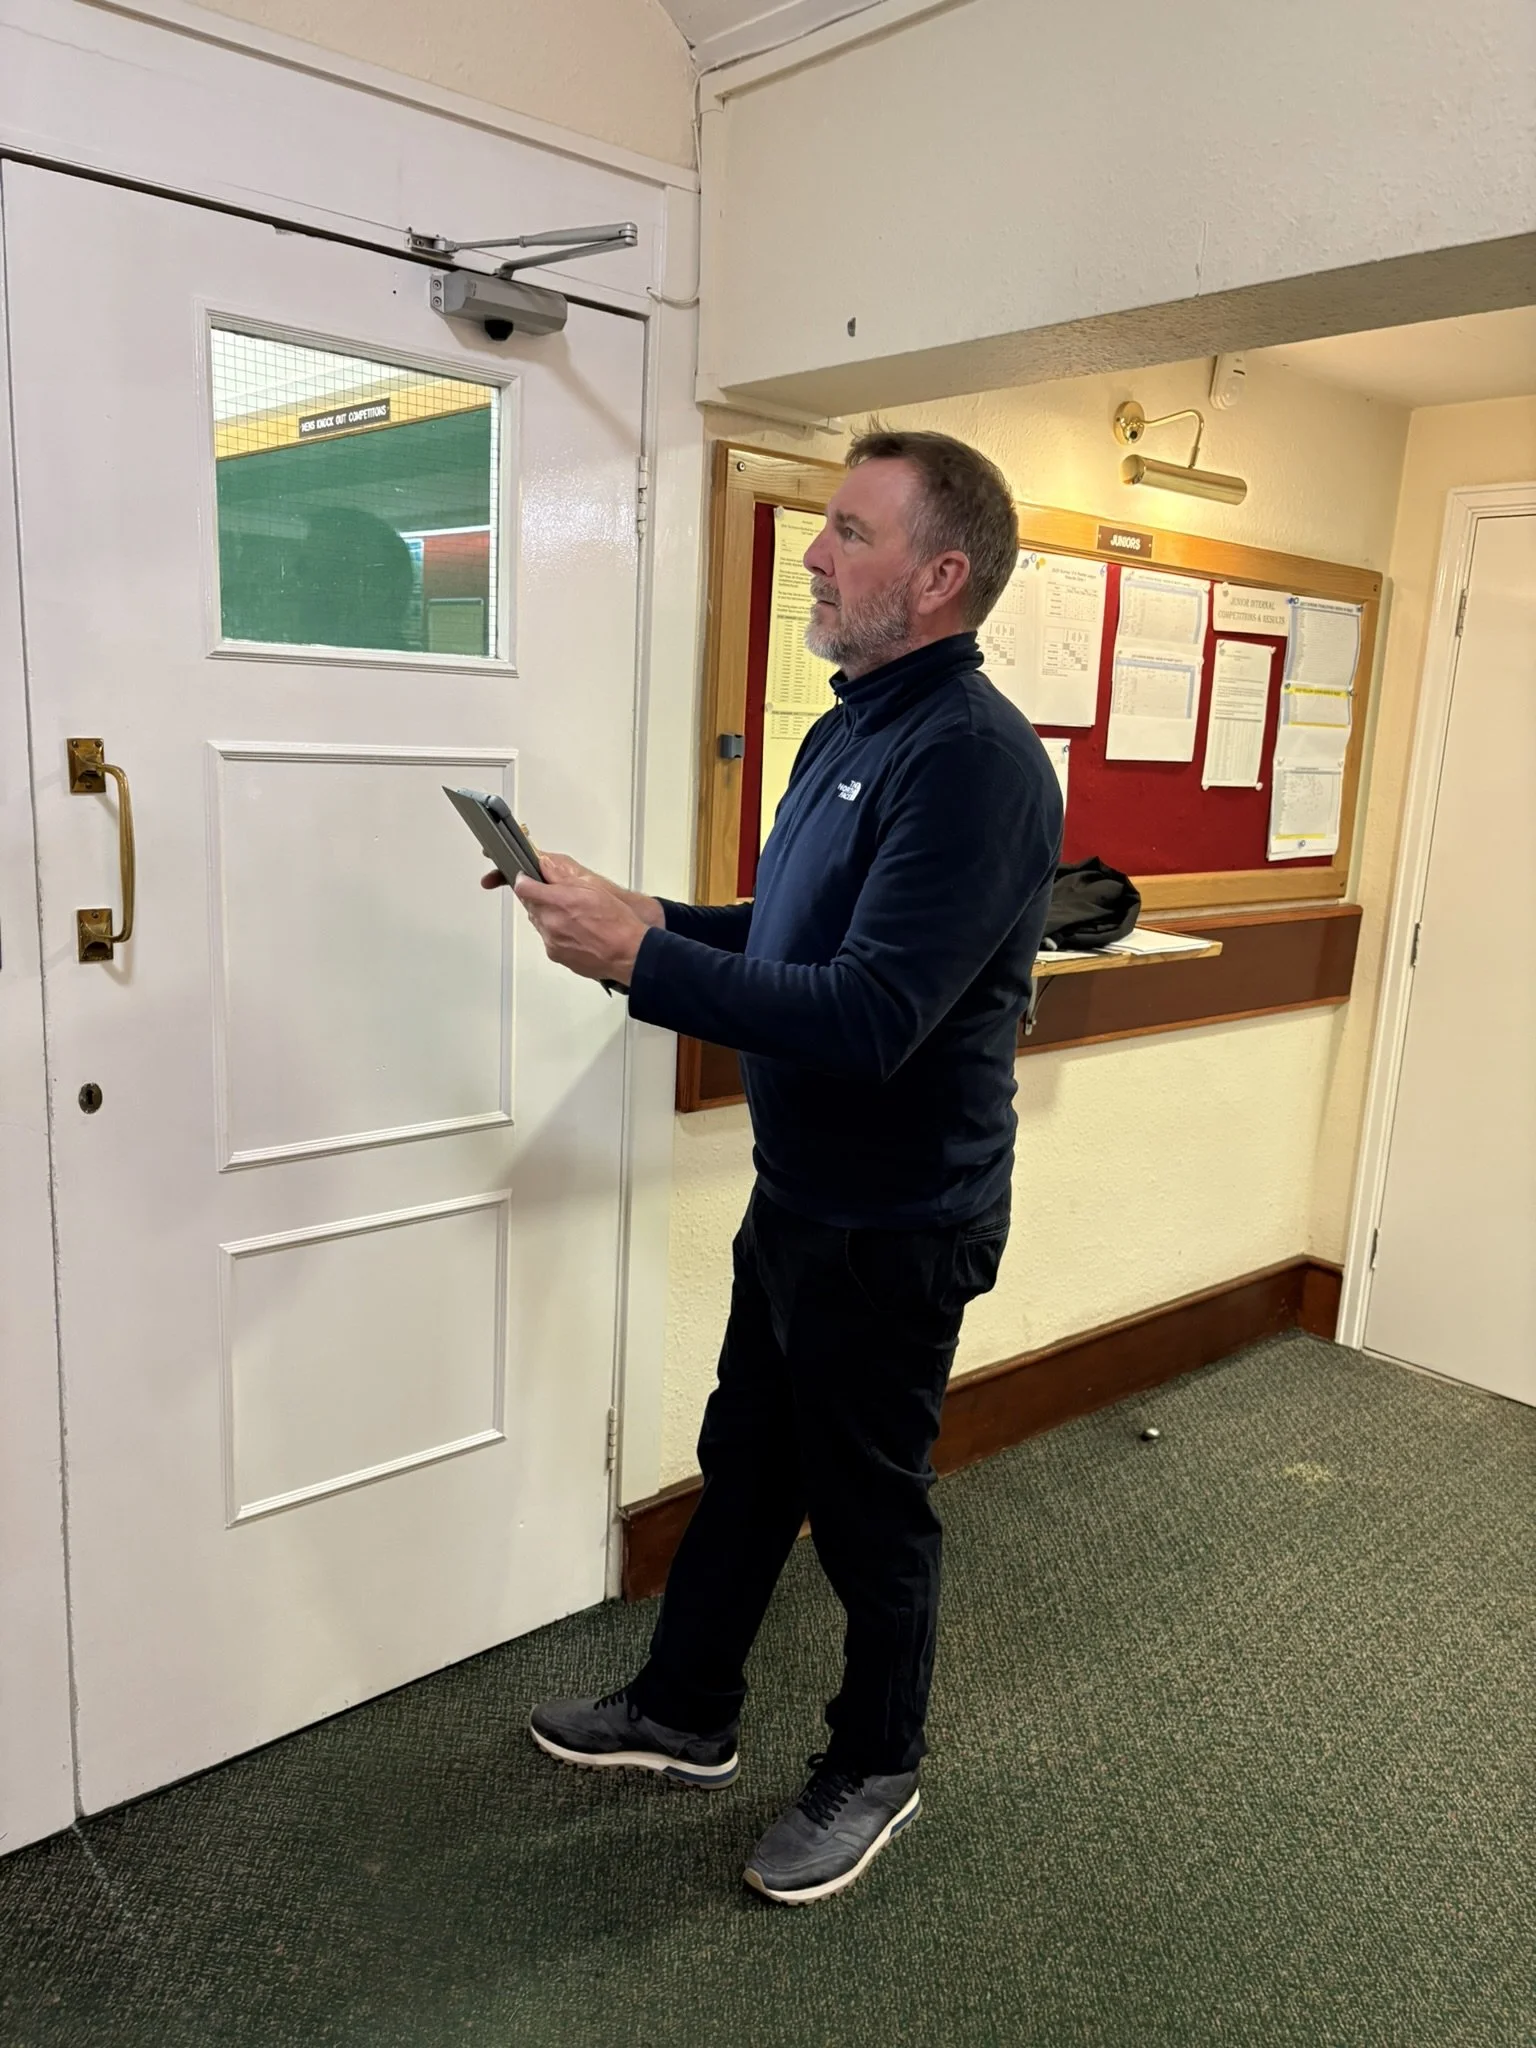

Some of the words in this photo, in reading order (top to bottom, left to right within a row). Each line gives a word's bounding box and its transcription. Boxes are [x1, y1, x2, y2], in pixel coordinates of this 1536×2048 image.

[317, 417, 335, 429] KNOCK
[336, 413, 347, 425] OUT
[348, 405, 387, 423] COMPETITIONS
[1110, 534, 1141, 550] JUNIORS
[1230, 597, 1250, 607] JUNIOR
[1250, 599, 1275, 610] INTERNAL
[1218, 610, 1257, 621] COMPETITIONS
[1262, 615, 1285, 625] RESULTS
